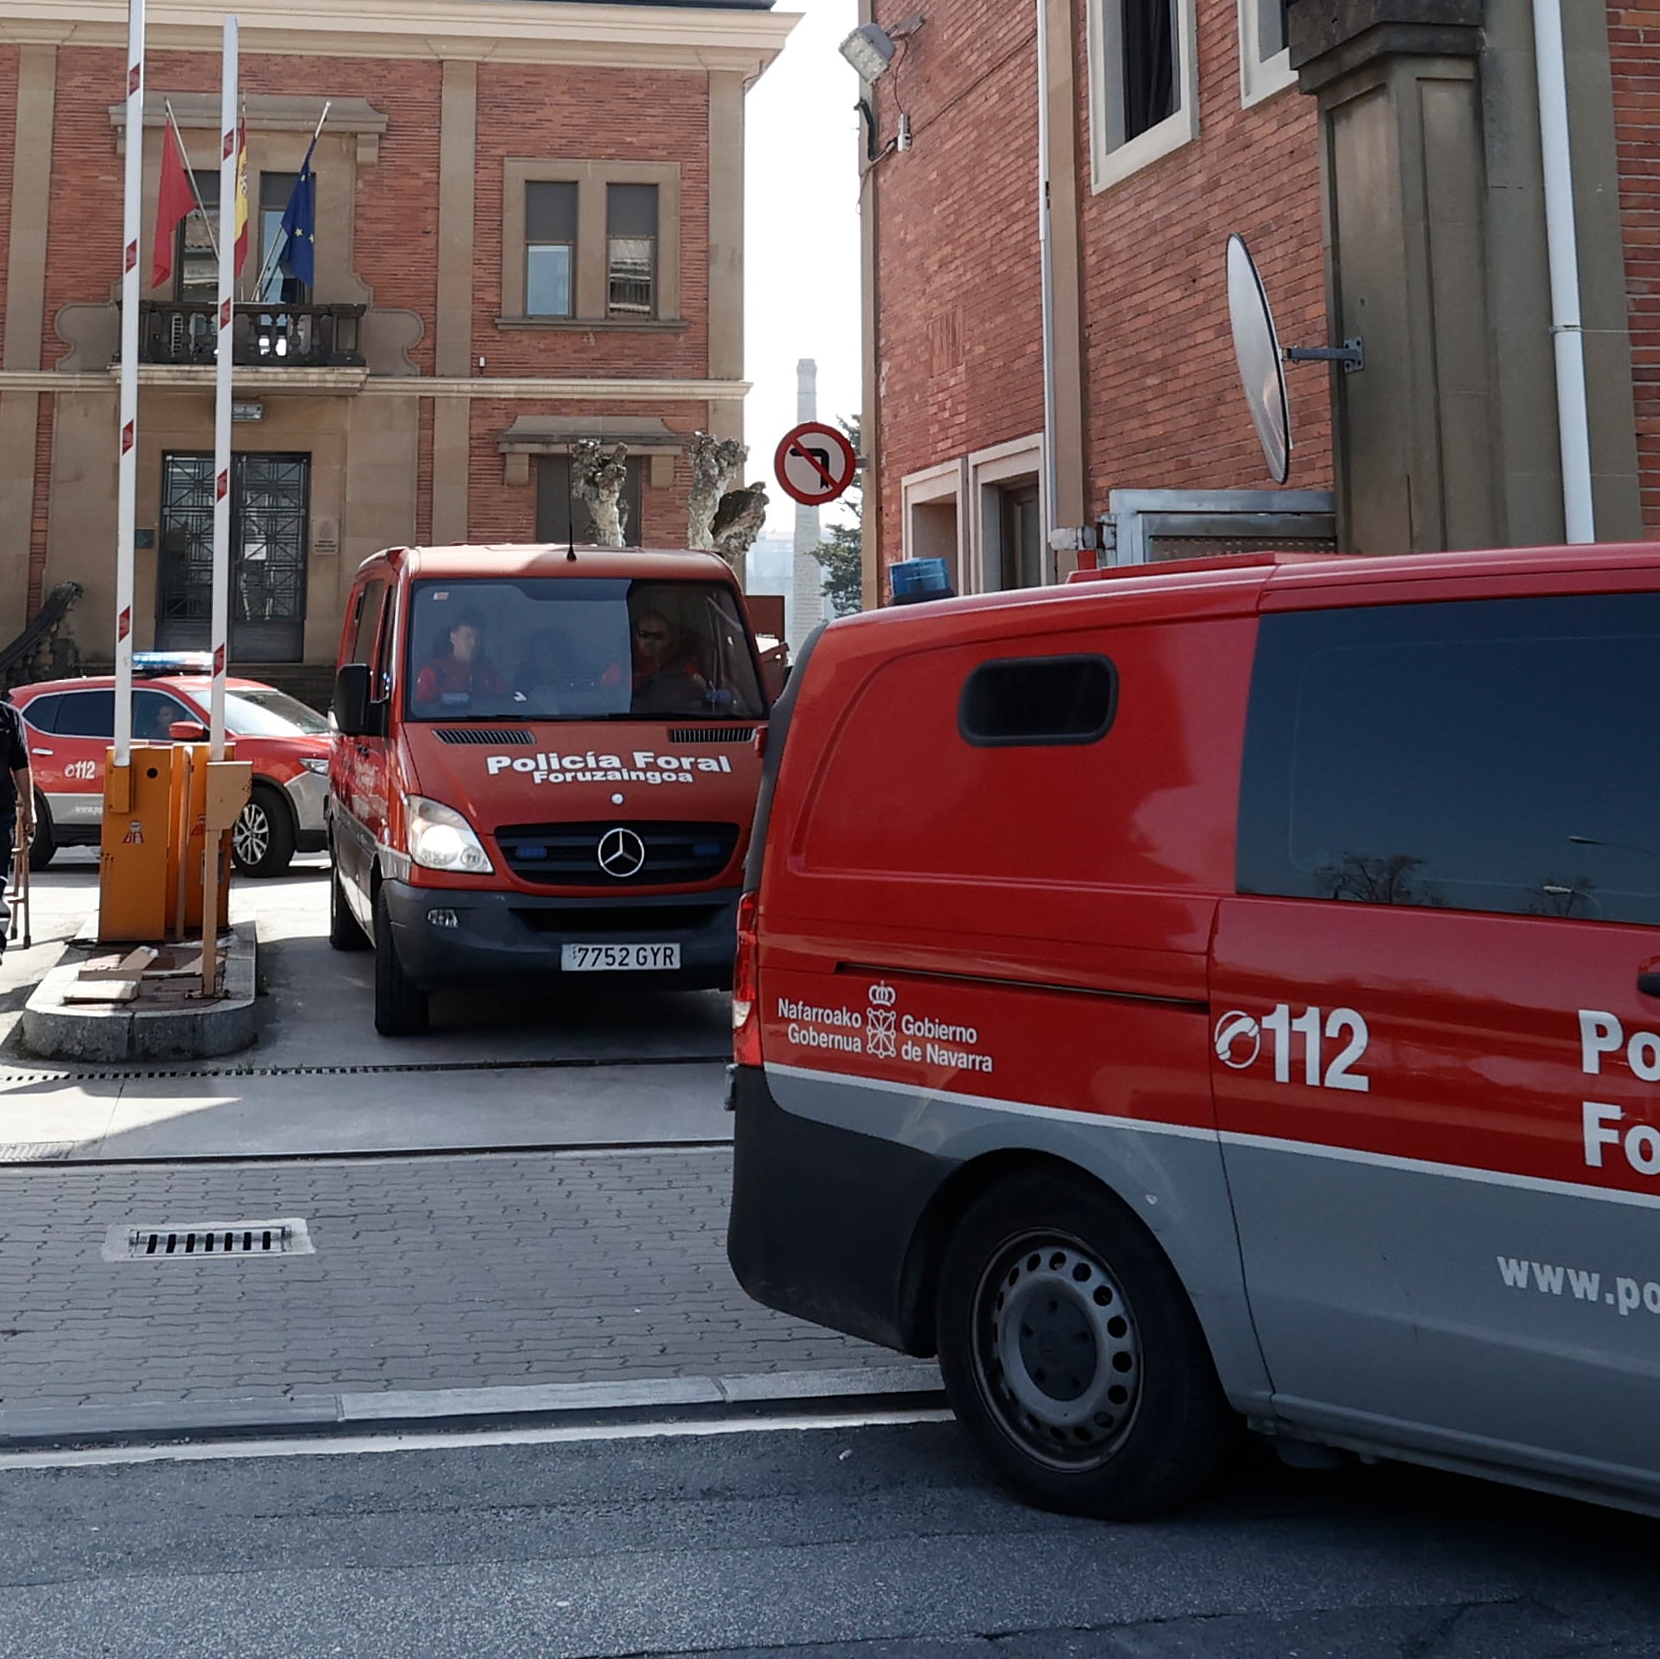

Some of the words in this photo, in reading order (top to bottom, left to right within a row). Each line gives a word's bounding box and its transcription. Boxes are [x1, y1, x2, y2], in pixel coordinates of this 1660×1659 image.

[75, 761, 95, 779] 112
[486, 751, 622, 775] Policía
[633, 752, 732, 773] Foral
[533, 769, 694, 784] Foruzaingoa
[577, 947, 629, 967] 7752
[636, 947, 674, 966] GYR
[778, 998, 862, 1028] Nafarroako
[787, 1026, 862, 1053] Gobernua
[900, 1015, 978, 1044] Gobierno
[901, 1039, 922, 1061] de
[926, 1042, 993, 1072] Navarra
[1262, 1003, 1369, 1092] 112
